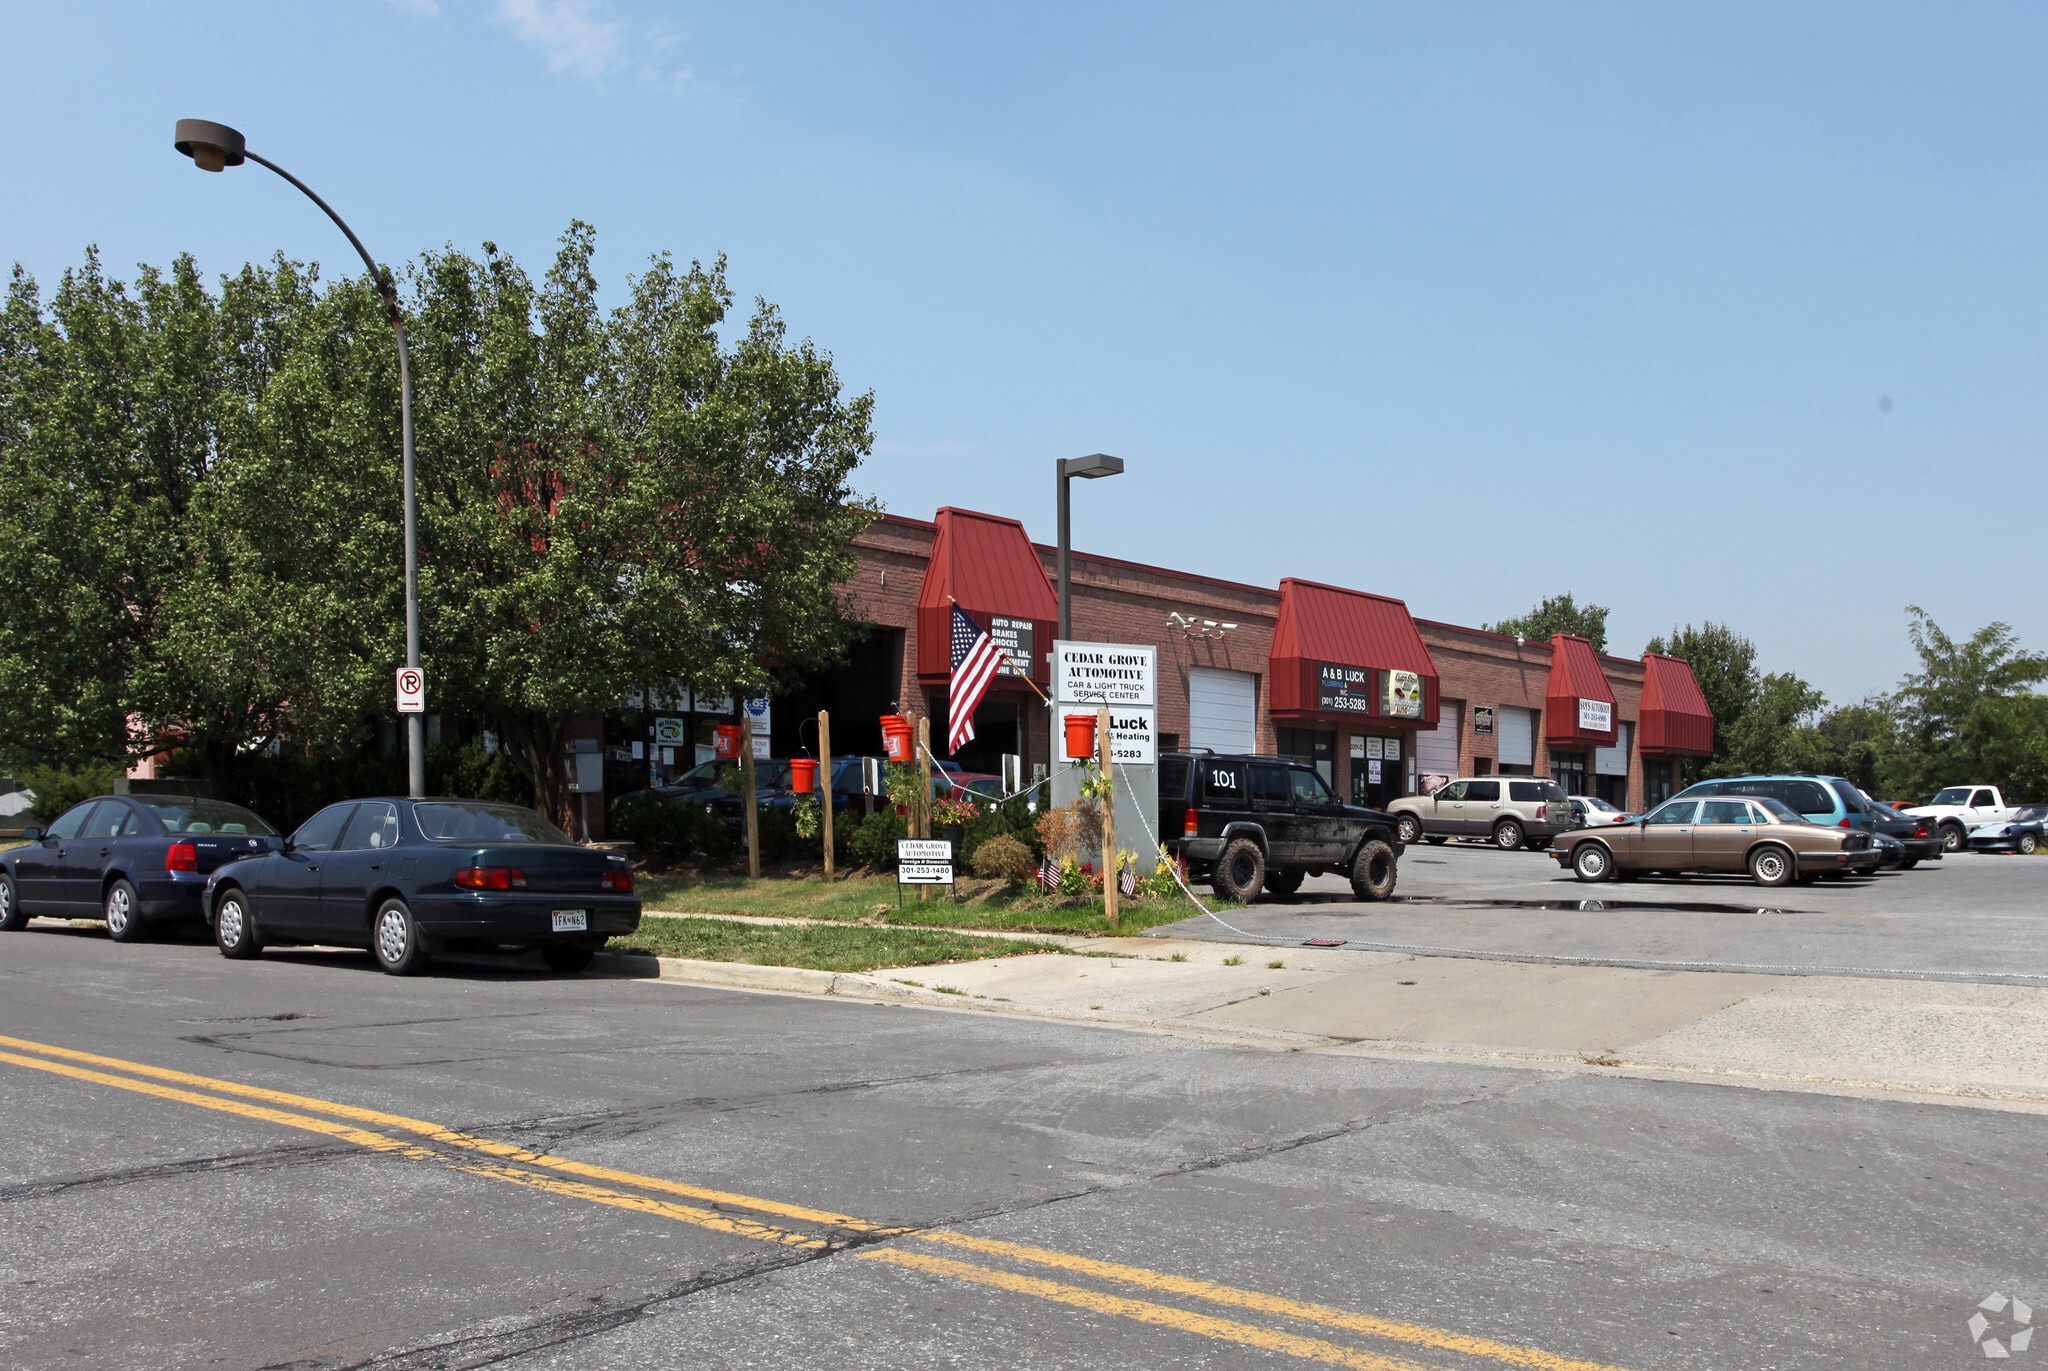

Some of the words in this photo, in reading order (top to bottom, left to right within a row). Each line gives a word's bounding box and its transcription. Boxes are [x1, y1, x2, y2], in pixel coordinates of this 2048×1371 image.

[992, 618, 1008, 627] AUTO
[1011, 620, 1033, 631] REPAIR
[991, 628, 1018, 638] BRAKES
[1017, 649, 1031, 659] BAL.
[1064, 652, 1104, 664] CEDAR
[1108, 654, 1147, 667] GROVE
[1068, 667, 1143, 681] AUTOMOTIVE
[1322, 667, 1329, 679] A
[1330, 668, 1336, 679] &
[1337, 669, 1343, 680] B
[1345, 670, 1365, 683] LUCK
[1067, 681, 1084, 689] CAR
[1094, 682, 1117, 690] LIGHT
[1119, 683, 1145, 691] TRUCK
[1073, 690, 1107, 698] SERVICE
[1109, 691, 1140, 700] CENTER
[1334, 696, 1366, 711] 253-5283
[1110, 715, 1148, 730] Luck
[1116, 732, 1150, 742] Heating
[1212, 769, 1237, 789] 101
